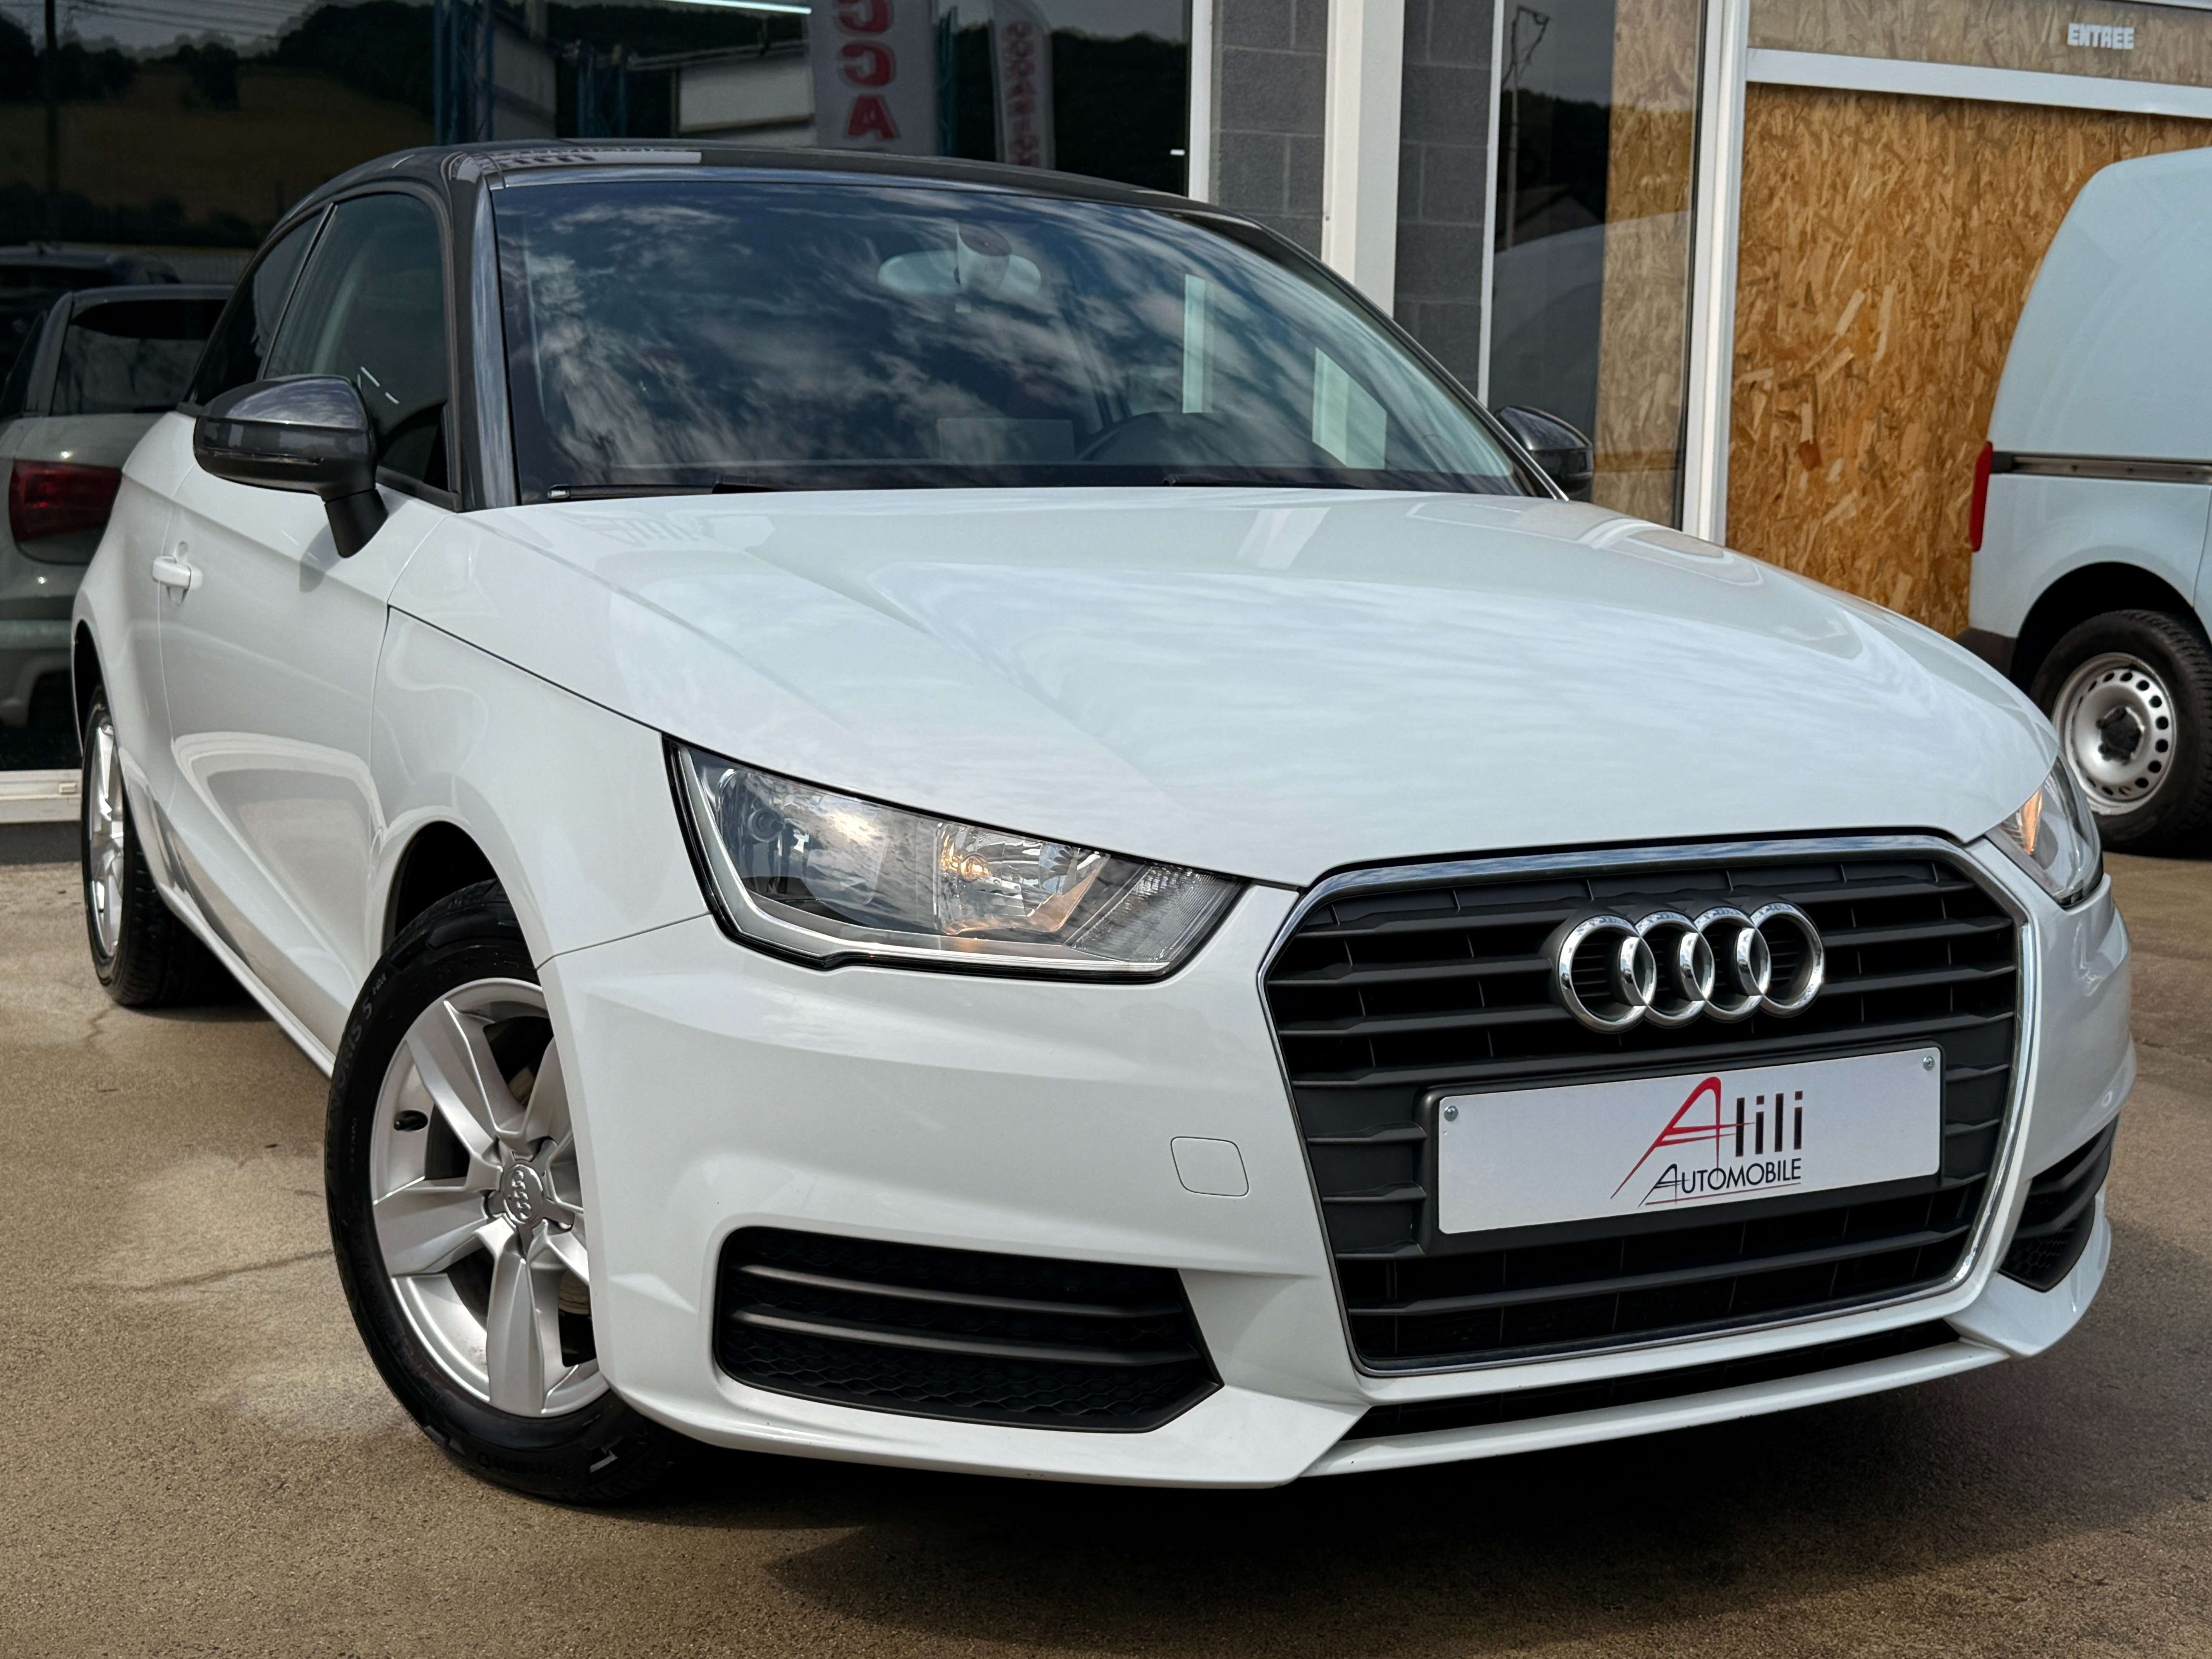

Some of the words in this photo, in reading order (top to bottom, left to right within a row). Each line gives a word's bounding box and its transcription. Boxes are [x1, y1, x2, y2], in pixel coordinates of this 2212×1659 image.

[2067, 22, 2135, 50] ENTREE
[1610, 1077, 1803, 1199] Alili
[1638, 1158, 1801, 1208] AUTOMOBILE
